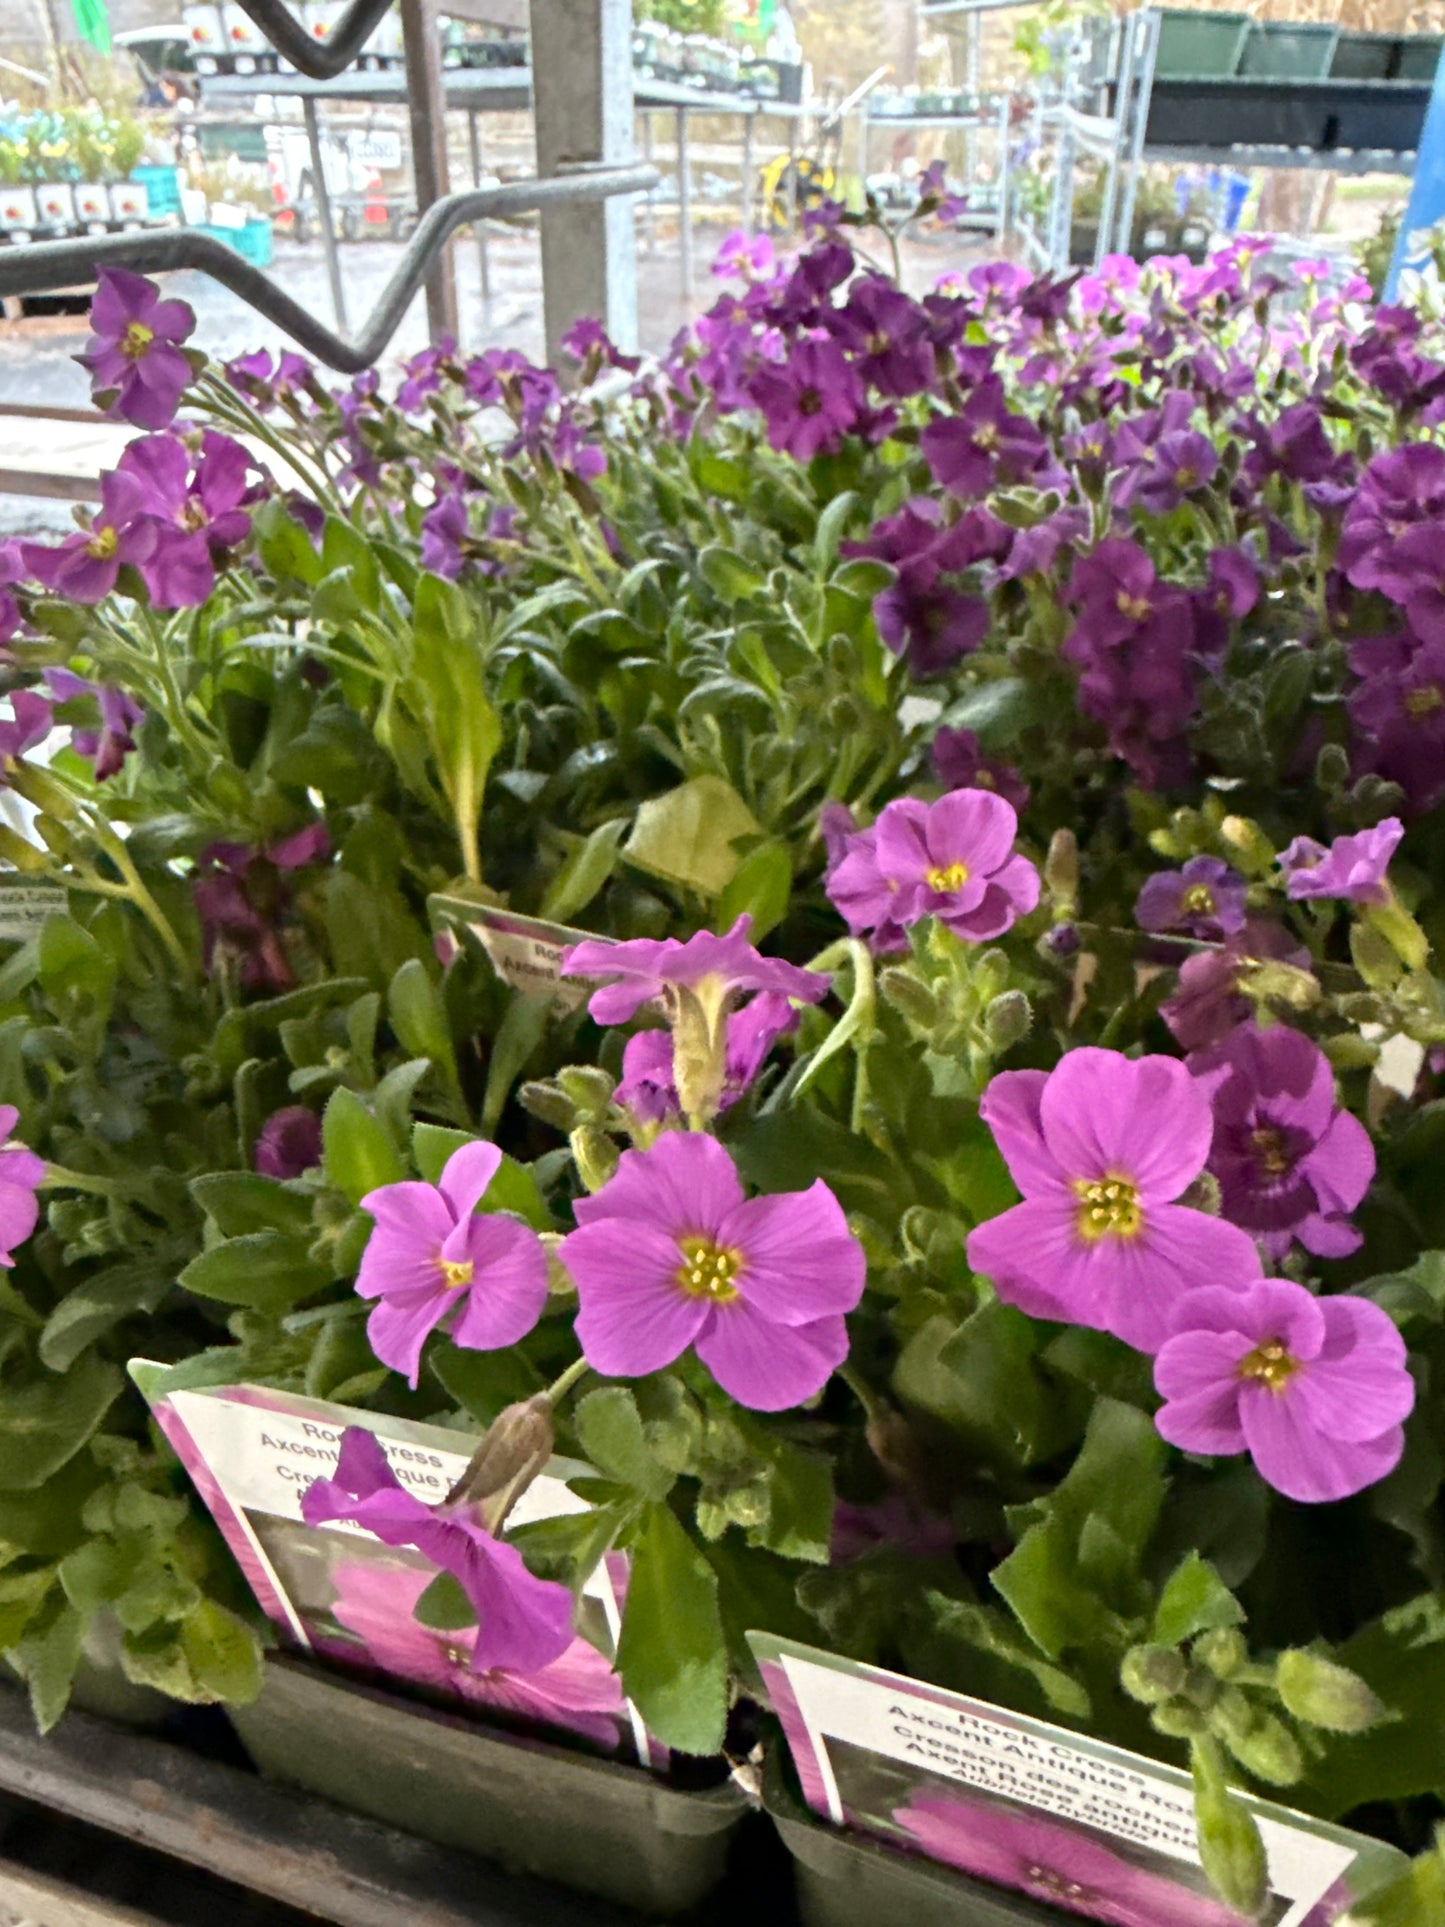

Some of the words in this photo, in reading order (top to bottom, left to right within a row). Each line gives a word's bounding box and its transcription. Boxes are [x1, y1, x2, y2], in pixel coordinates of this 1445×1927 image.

[302, 1422, 341, 1443] Ro
[380, 1441, 443, 1468] ress
[888, 1706, 992, 1746] Axcent
[1003, 1744, 1127, 1792] Antique
[893, 1725, 1015, 1772] Cresson
[1026, 1771, 1080, 1795] des
[1092, 1794, 1195, 1834] rocher
[959, 1714, 1038, 1749] Rock
[1050, 1746, 1146, 1785] Cress
[998, 1772, 1072, 1804] Rose
